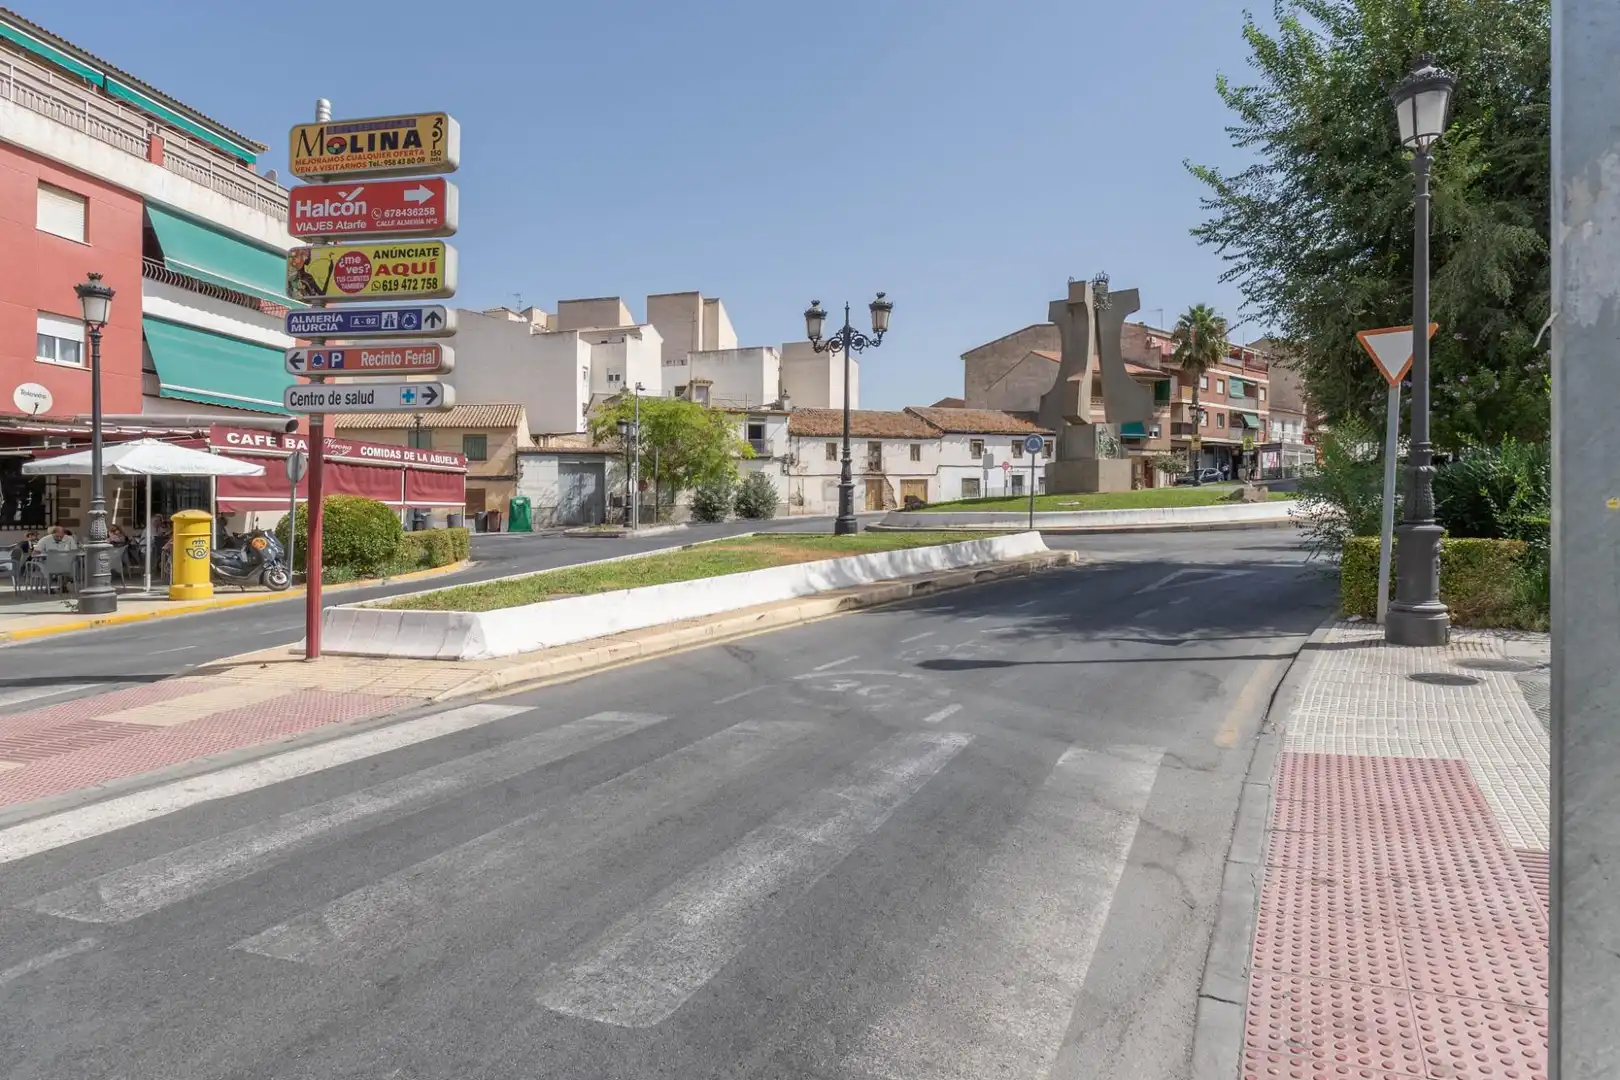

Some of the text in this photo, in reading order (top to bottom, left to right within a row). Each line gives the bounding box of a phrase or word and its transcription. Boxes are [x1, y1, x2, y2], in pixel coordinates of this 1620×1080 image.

[296, 127, 422, 158] MOLINA
[295, 149, 425, 165] MEJORAMOS CUALQUIER OFERTA
[320, 162, 368, 172] VISITARNOS
[296, 195, 366, 218] Halcón
[384, 207, 436, 218] 678436258
[296, 220, 366, 232] VIAJES Atarfe
[373, 247, 440, 260] ANÚNCIATE
[339, 256, 361, 268] ¿me
[346, 263, 370, 274] ves?
[374, 258, 438, 277] AQUÍ
[382, 277, 438, 292] 619 472 758
[291, 313, 344, 324] ALMERÍA
[291, 324, 338, 332] MURCIA
[361, 350, 435, 366] Recinto Ferial
[290, 390, 374, 406] Centro de salud
[226, 432, 277, 447] CAFE
[360, 446, 458, 466] COMIDAS DE LA ABUELA
